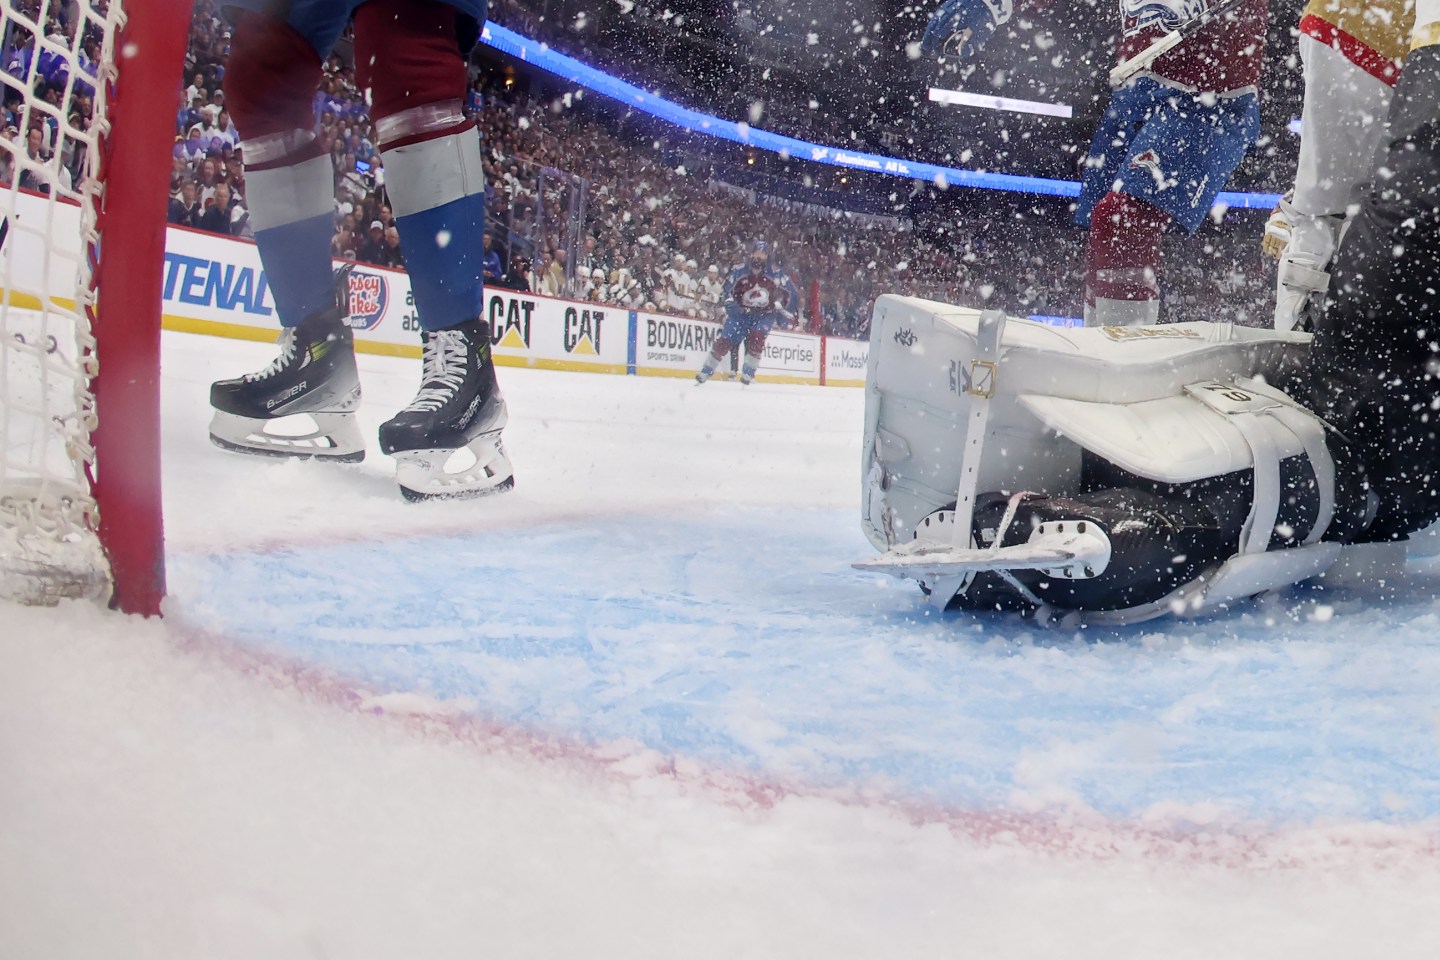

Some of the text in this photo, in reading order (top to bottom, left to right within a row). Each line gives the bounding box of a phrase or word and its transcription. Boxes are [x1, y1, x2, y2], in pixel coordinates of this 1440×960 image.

[489, 295, 535, 349] CAT
[563, 306, 604, 355] CAT
[647, 319, 723, 353] BODYARM
[647, 352, 687, 362] SPORTS DRINK
[762, 342, 814, 365] nterprise
[266, 380, 308, 409] BER
